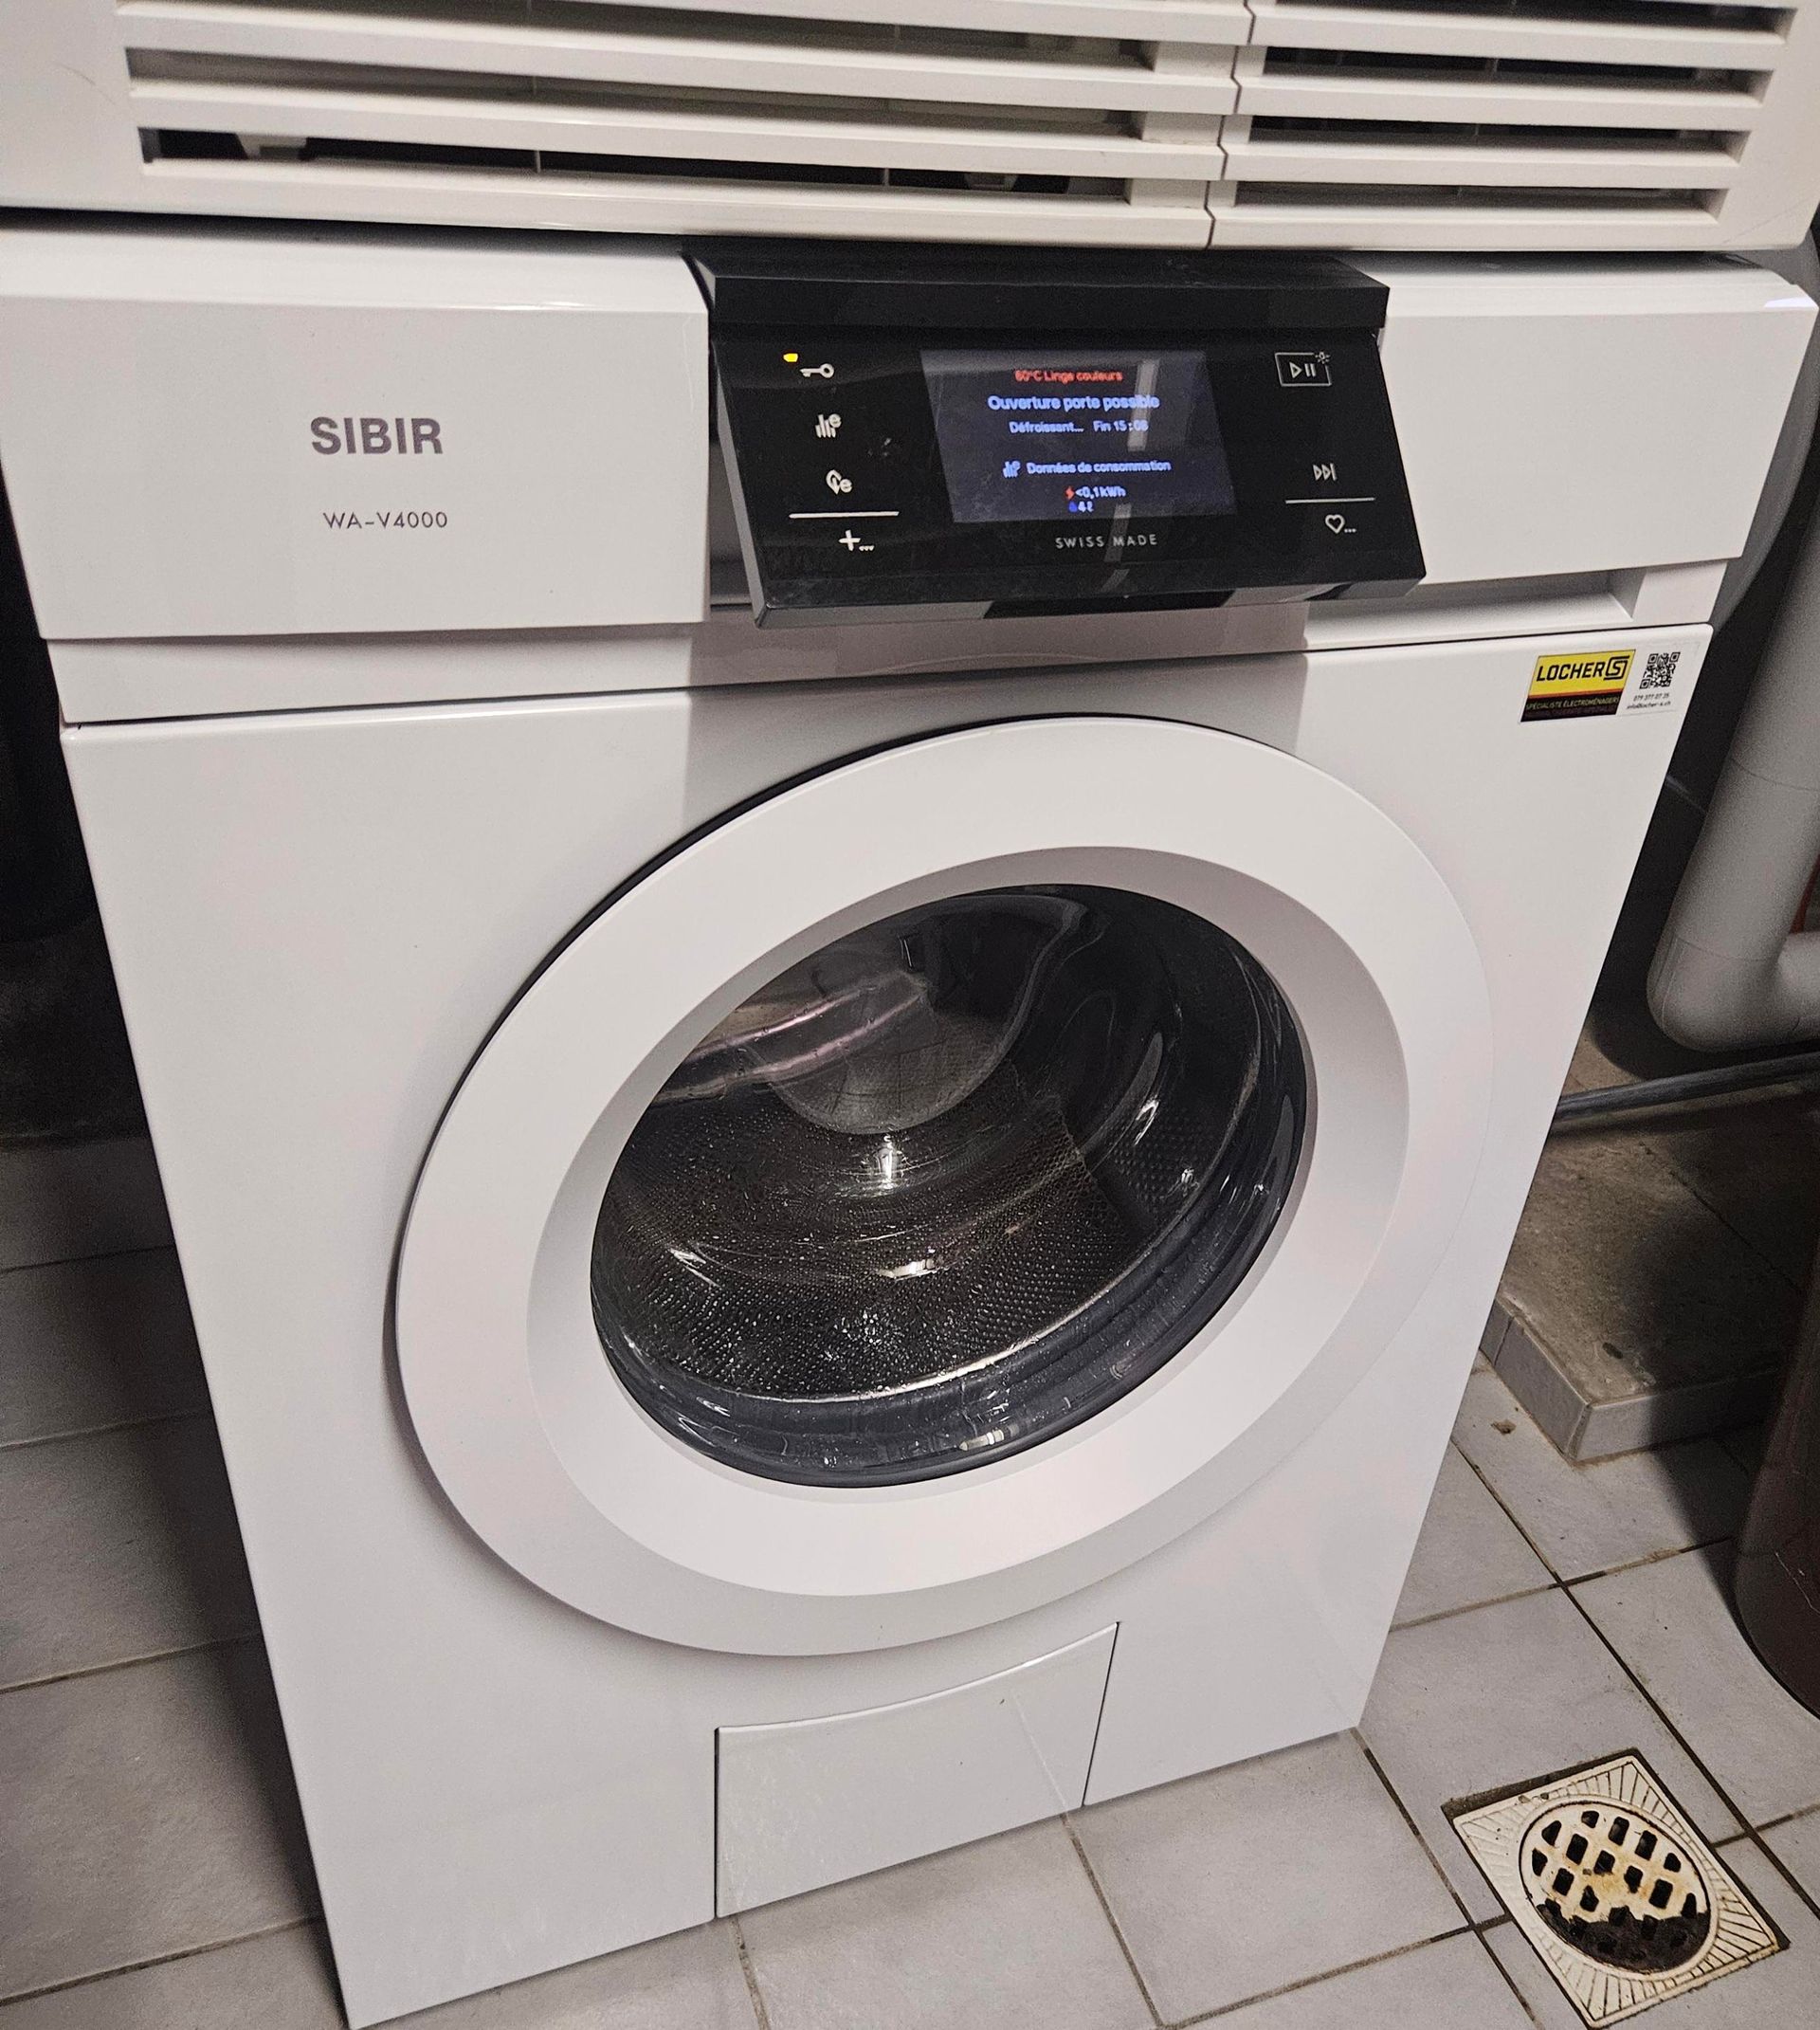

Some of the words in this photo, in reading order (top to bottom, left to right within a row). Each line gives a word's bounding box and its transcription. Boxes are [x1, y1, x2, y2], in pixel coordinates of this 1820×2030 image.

[1044, 370, 1074, 384] Linge
[1076, 371, 1123, 382] couleurs
[988, 395, 1062, 410] Ouverture
[1063, 396, 1101, 411] porte
[1102, 394, 1160, 411] possible
[1009, 420, 1084, 433] Défroissant...
[1093, 420, 1112, 432] Fin
[310, 416, 443, 455] SIBIR
[1026, 462, 1077, 474] Données
[1077, 462, 1092, 473] de
[1093, 460, 1172, 472] consommation
[322, 510, 448, 530] WA-V4000
[1055, 536, 1105, 549] SWISS
[1113, 534, 1158, 547] MADE
